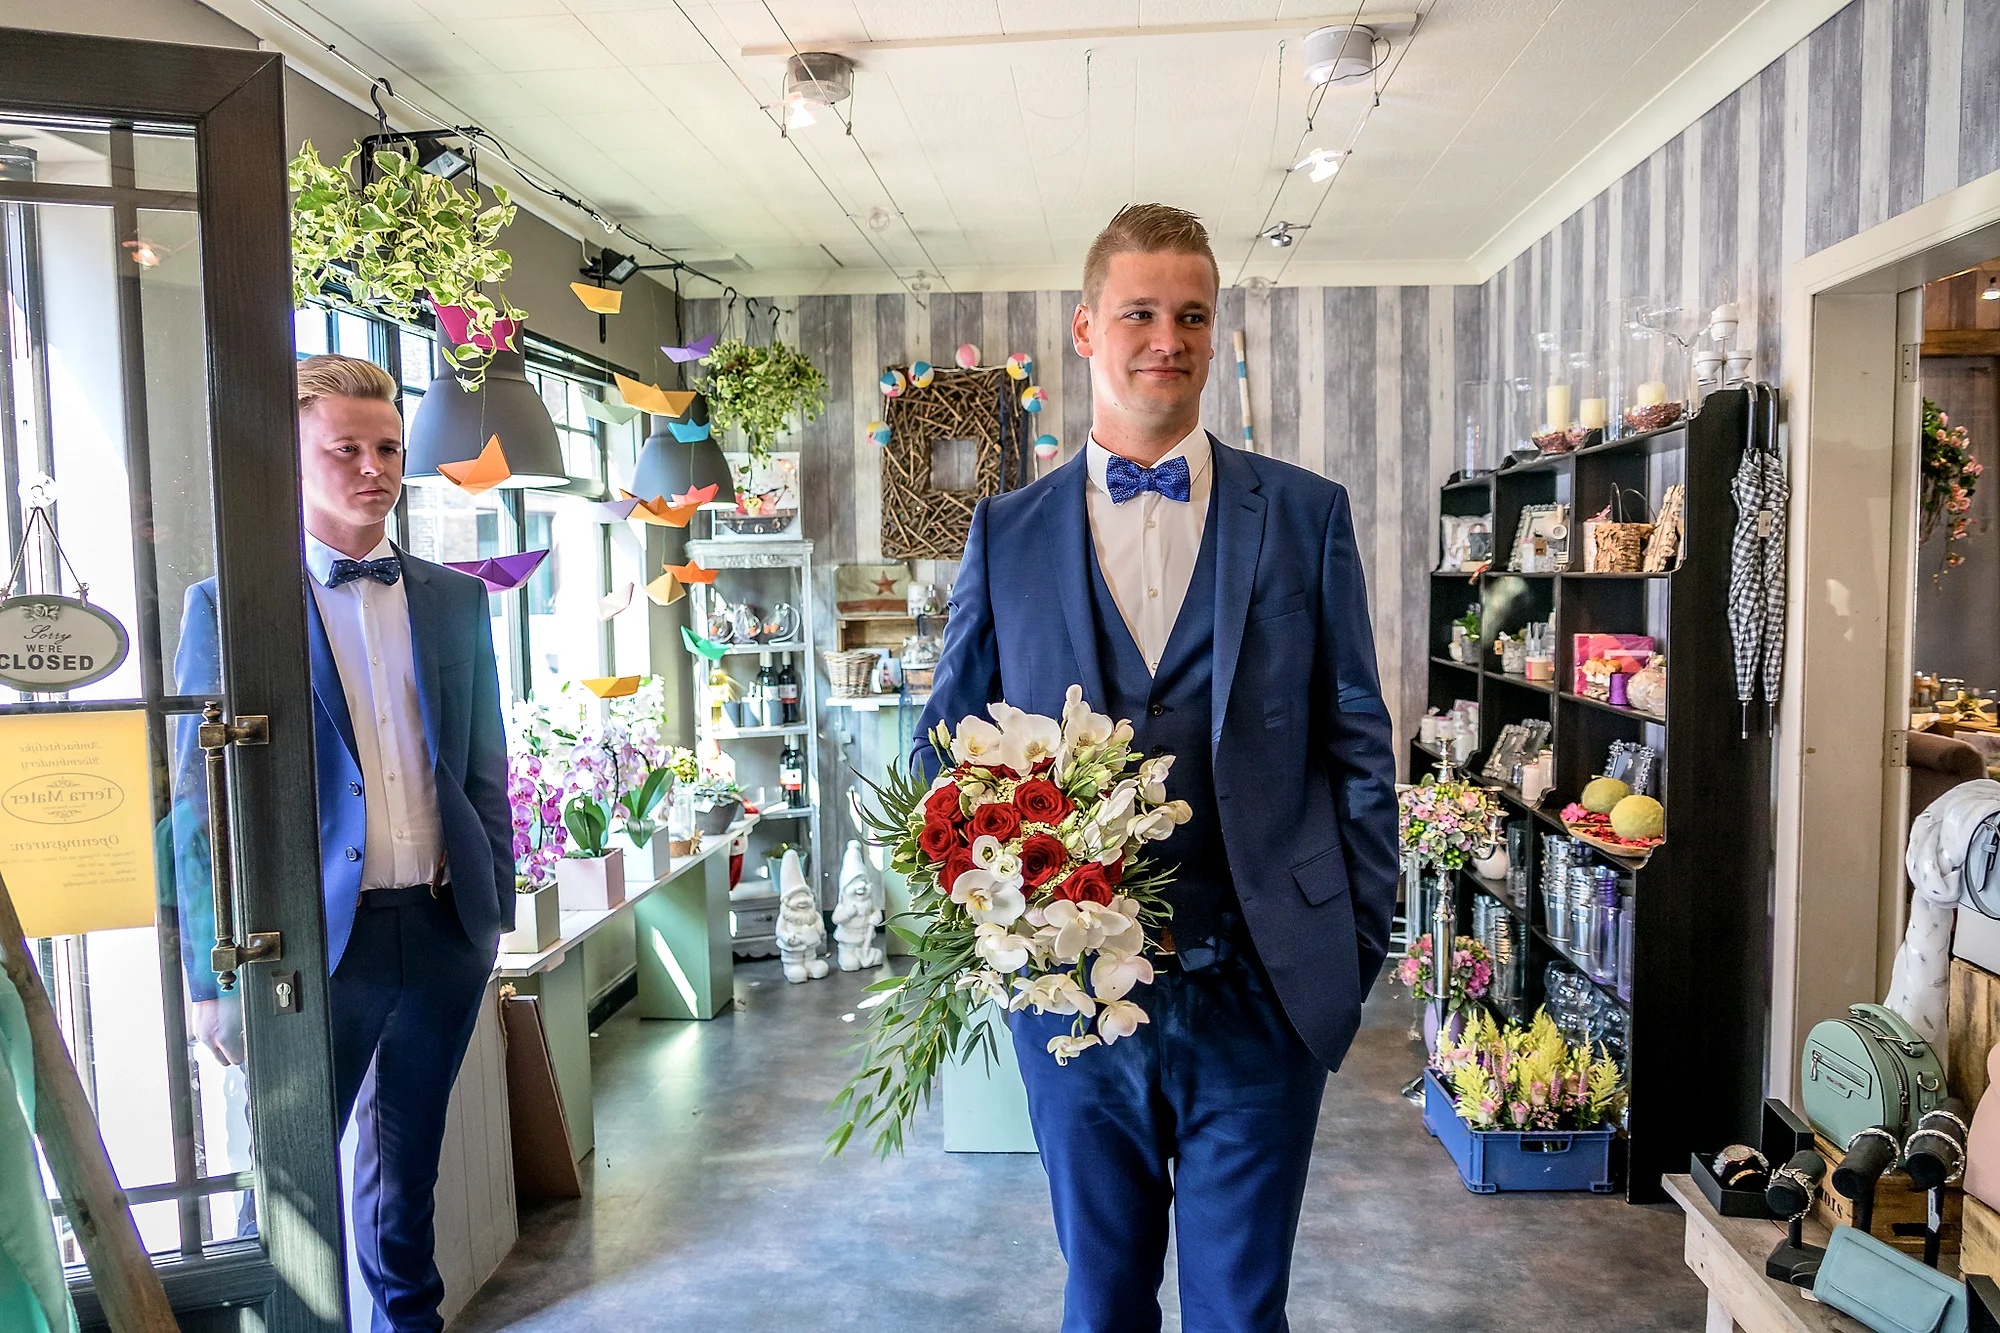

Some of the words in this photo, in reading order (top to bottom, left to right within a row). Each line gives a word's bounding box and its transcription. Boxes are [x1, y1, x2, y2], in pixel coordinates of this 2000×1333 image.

[24, 625, 72, 645] Sorry
[26, 644, 63, 653] WE'RE
[0, 654, 94, 671] CLOSED
